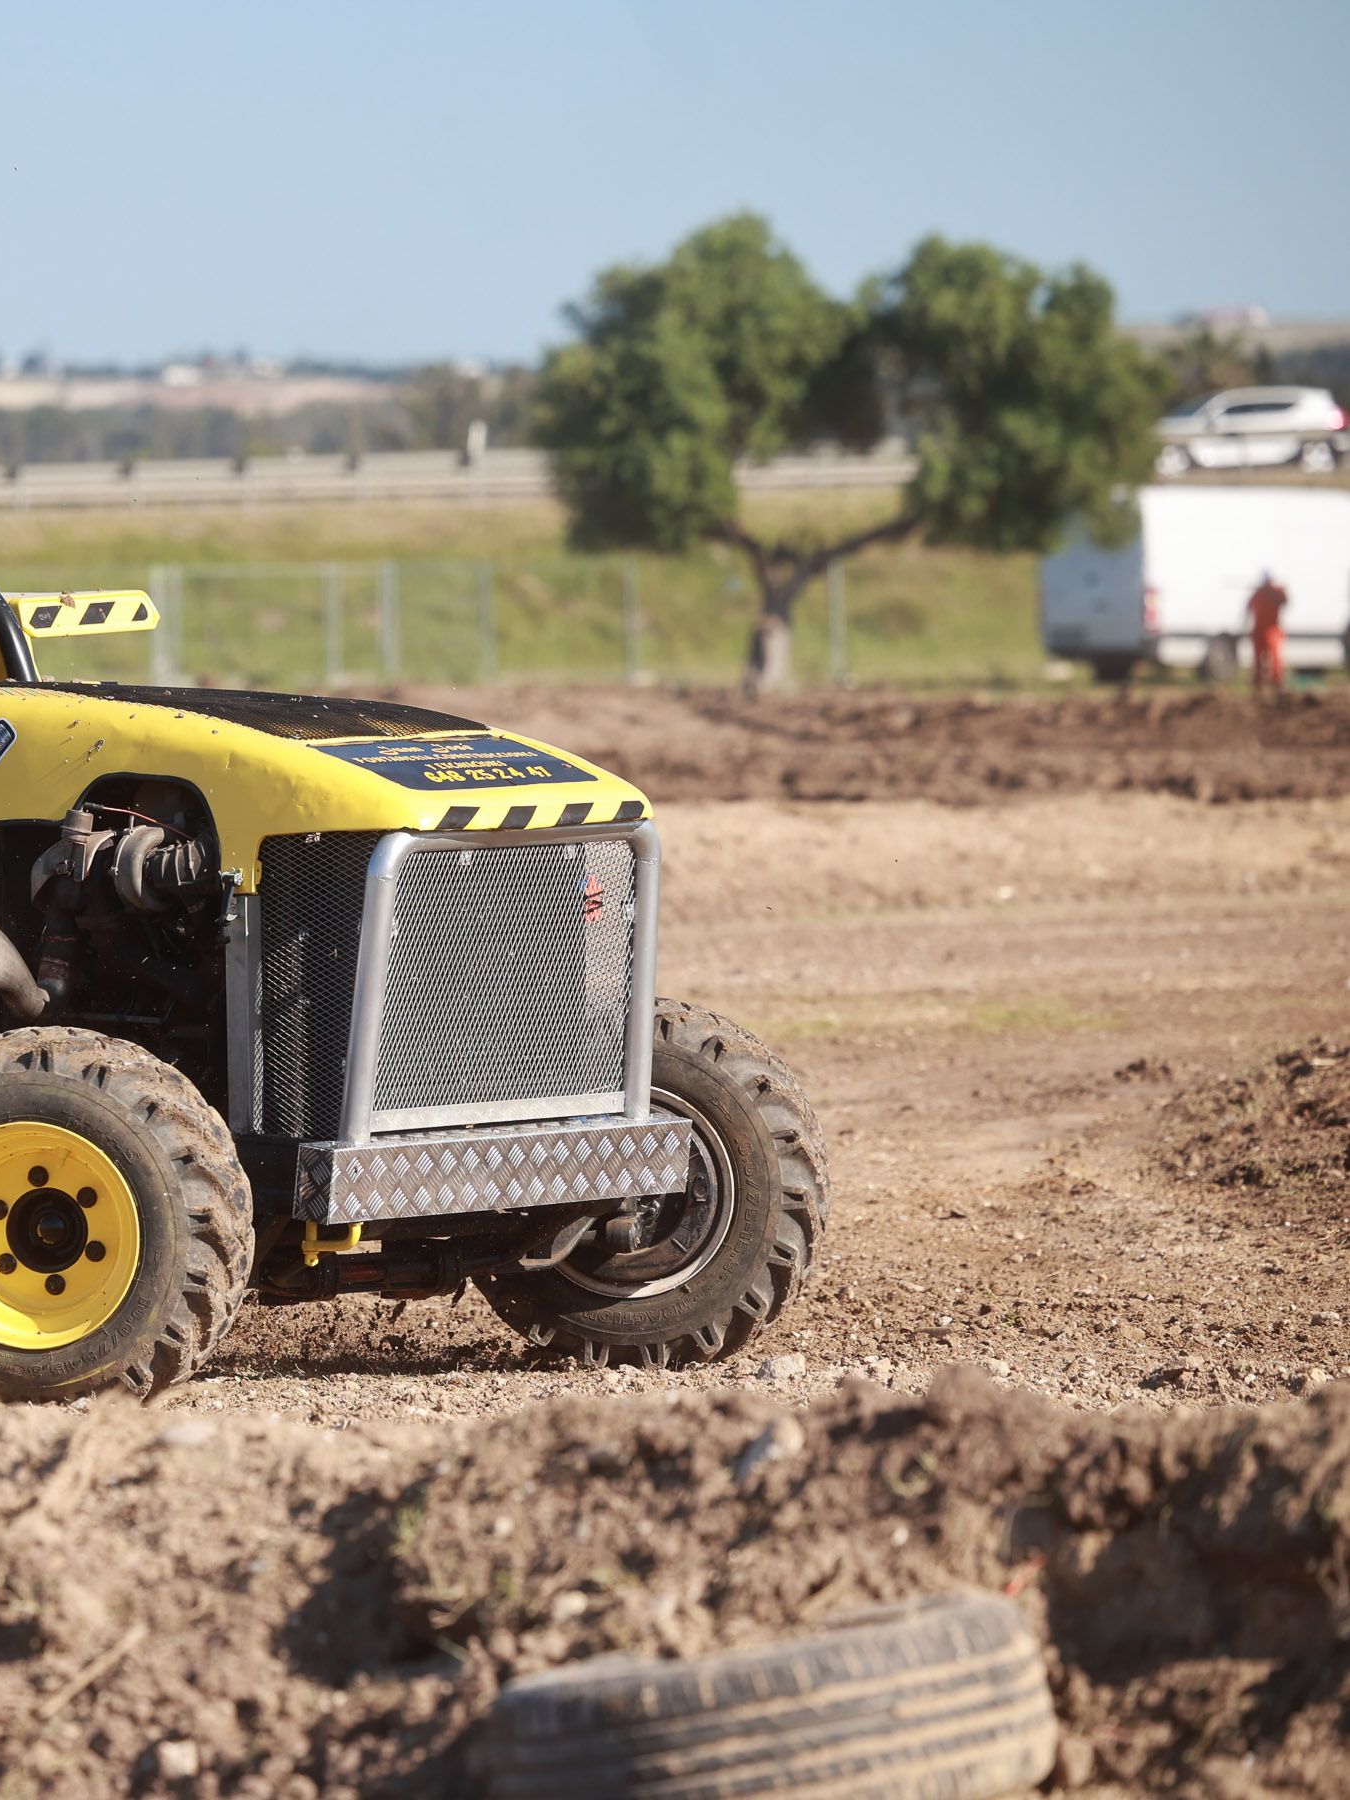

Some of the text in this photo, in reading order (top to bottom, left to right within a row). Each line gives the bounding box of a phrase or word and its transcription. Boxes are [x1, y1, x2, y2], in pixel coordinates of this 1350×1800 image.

[423, 765, 552, 783] 648 25 24 47
